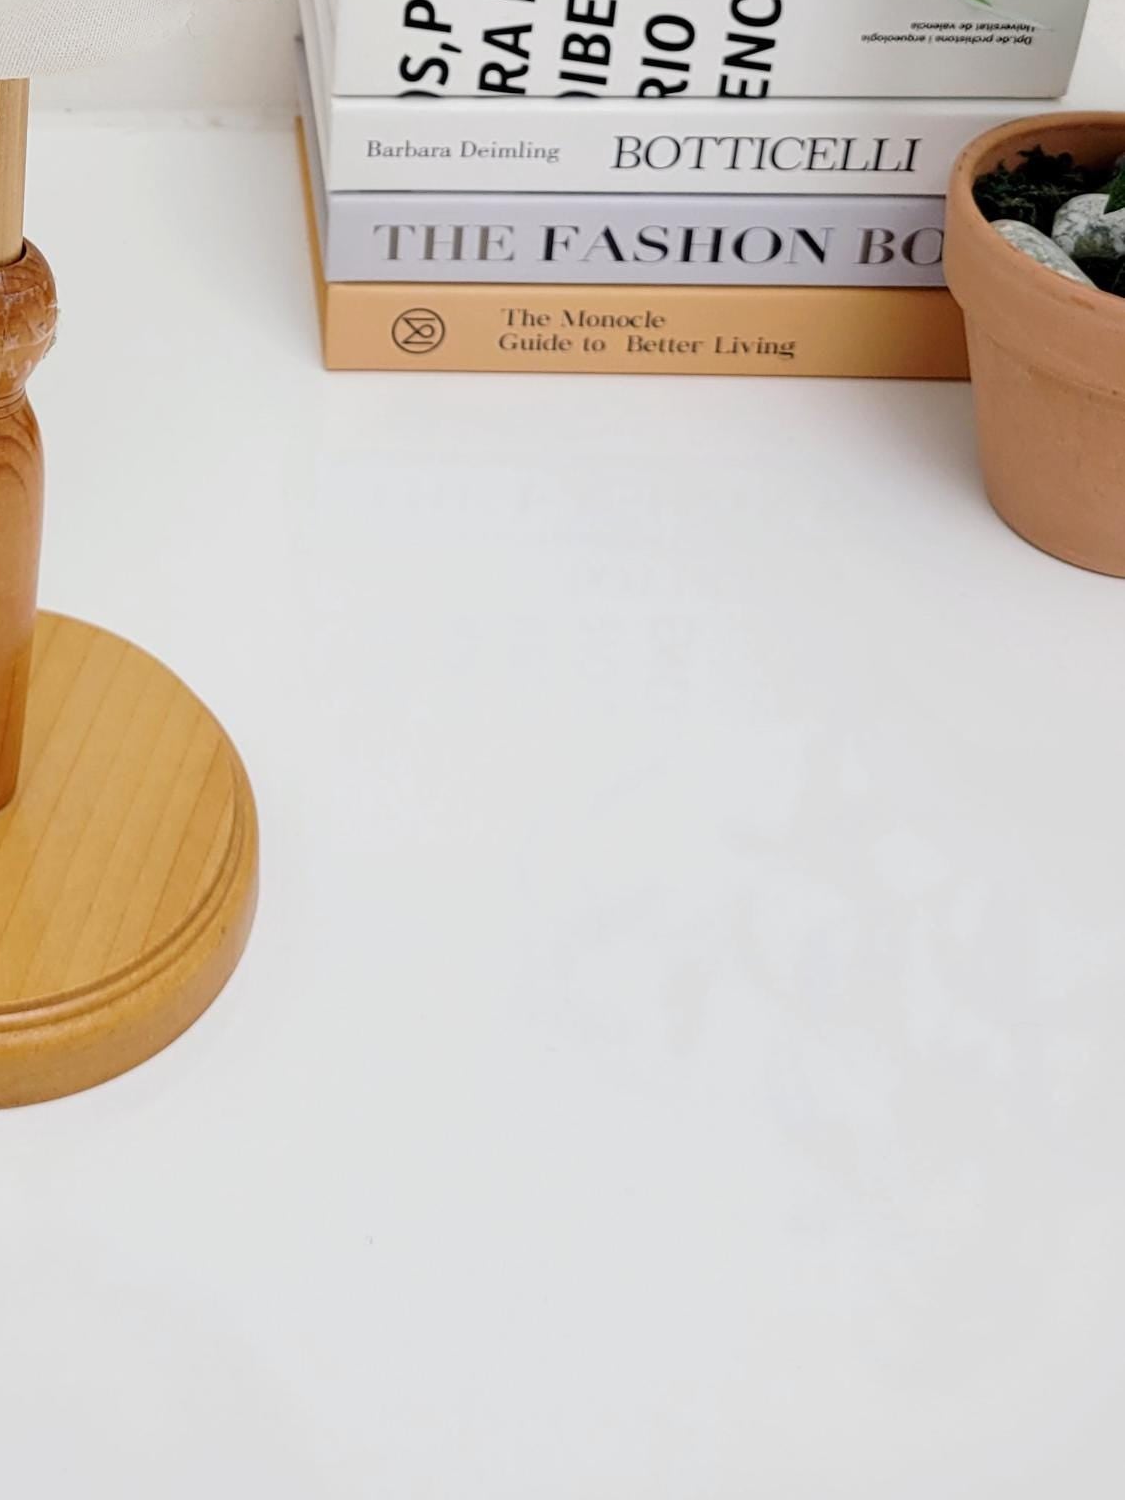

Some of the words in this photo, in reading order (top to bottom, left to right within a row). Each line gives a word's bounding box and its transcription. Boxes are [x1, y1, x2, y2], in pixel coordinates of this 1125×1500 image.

[478, 24, 533, 95] RA
[366, 139, 452, 159] Barbara
[460, 140, 561, 164] Deimling
[610, 135, 923, 173] BOTTICELLI
[373, 224, 516, 263] THE
[537, 225, 834, 266] FASHON
[500, 307, 552, 329] The
[559, 309, 667, 330] Monocle
[497, 332, 574, 354] Guide
[582, 335, 607, 354] to
[626, 336, 705, 356] Better
[713, 336, 797, 360] Living
